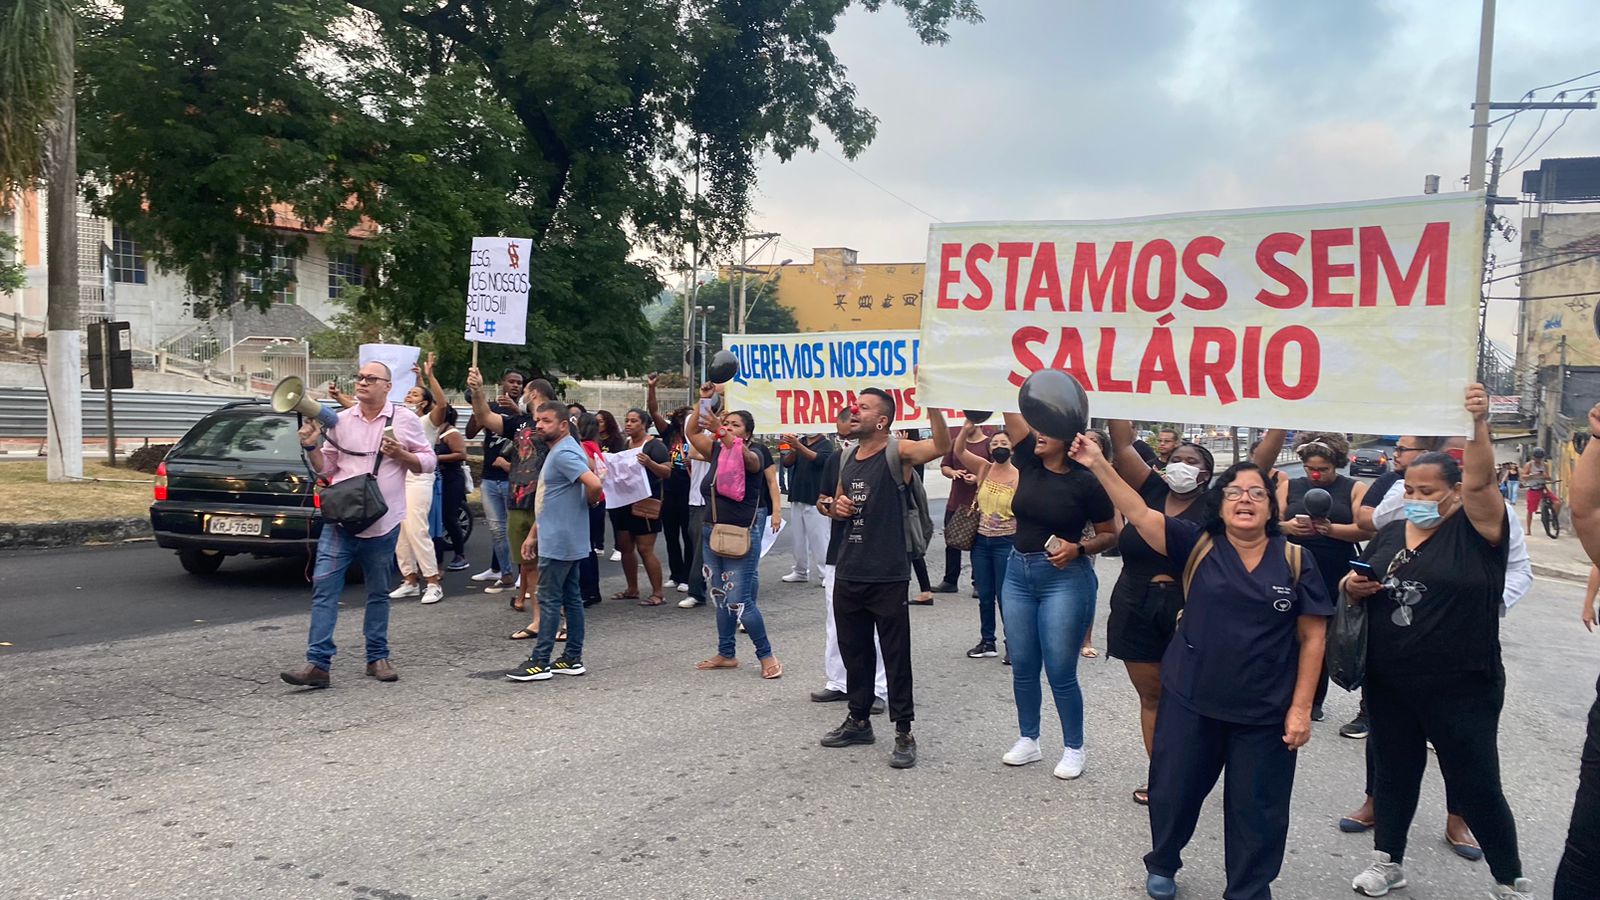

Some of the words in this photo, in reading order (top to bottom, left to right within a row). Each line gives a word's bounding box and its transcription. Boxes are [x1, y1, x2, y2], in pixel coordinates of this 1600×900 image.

[488, 273, 528, 294] NOSSOS
[936, 235, 1228, 313] ESTAMOS
[1255, 221, 1451, 309] SEM
[730, 342, 825, 386] QUEREMOS
[829, 340, 907, 378] NOSSOS
[1008, 312, 1321, 405] SALÁRIO
